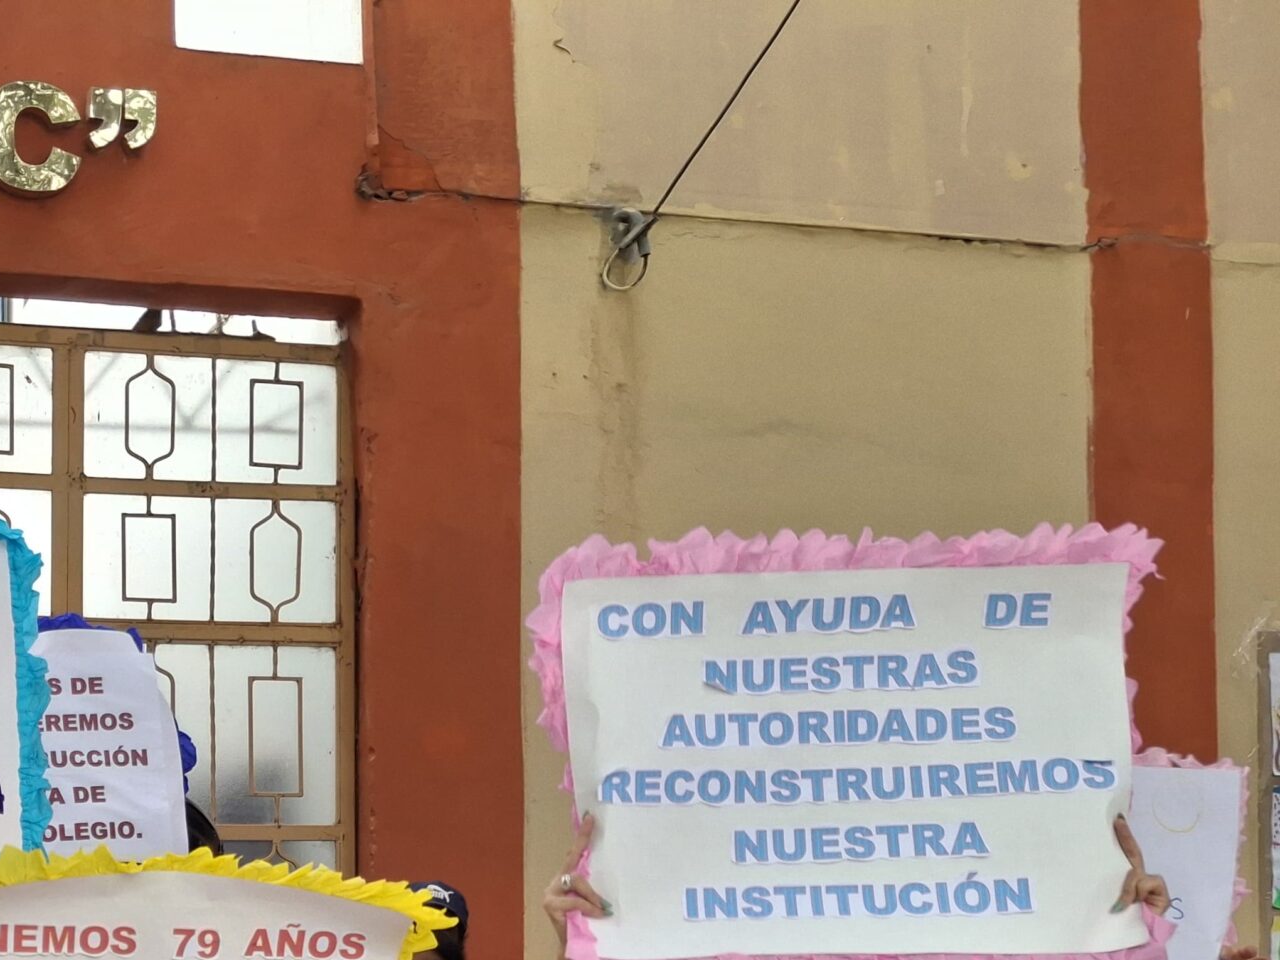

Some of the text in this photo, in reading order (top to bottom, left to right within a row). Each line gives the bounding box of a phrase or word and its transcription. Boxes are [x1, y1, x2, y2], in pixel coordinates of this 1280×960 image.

[597, 593, 1051, 639] CON AYUDA DE
[71, 677, 104, 695] DE
[705, 650, 978, 693] NUESTRAS
[661, 707, 1016, 747] AUTORIDADES
[47, 746, 148, 768] UCCIÓN
[73, 786, 106, 803] DE
[602, 758, 1116, 803] RECONSTRUIREMOS
[43, 821, 143, 843] OLEGIO.
[733, 822, 988, 863] NUESTRA
[684, 873, 1033, 920] INSTITUCIÓN
[173, 928, 220, 958] 79
[244, 924, 366, 960] AÑOS
